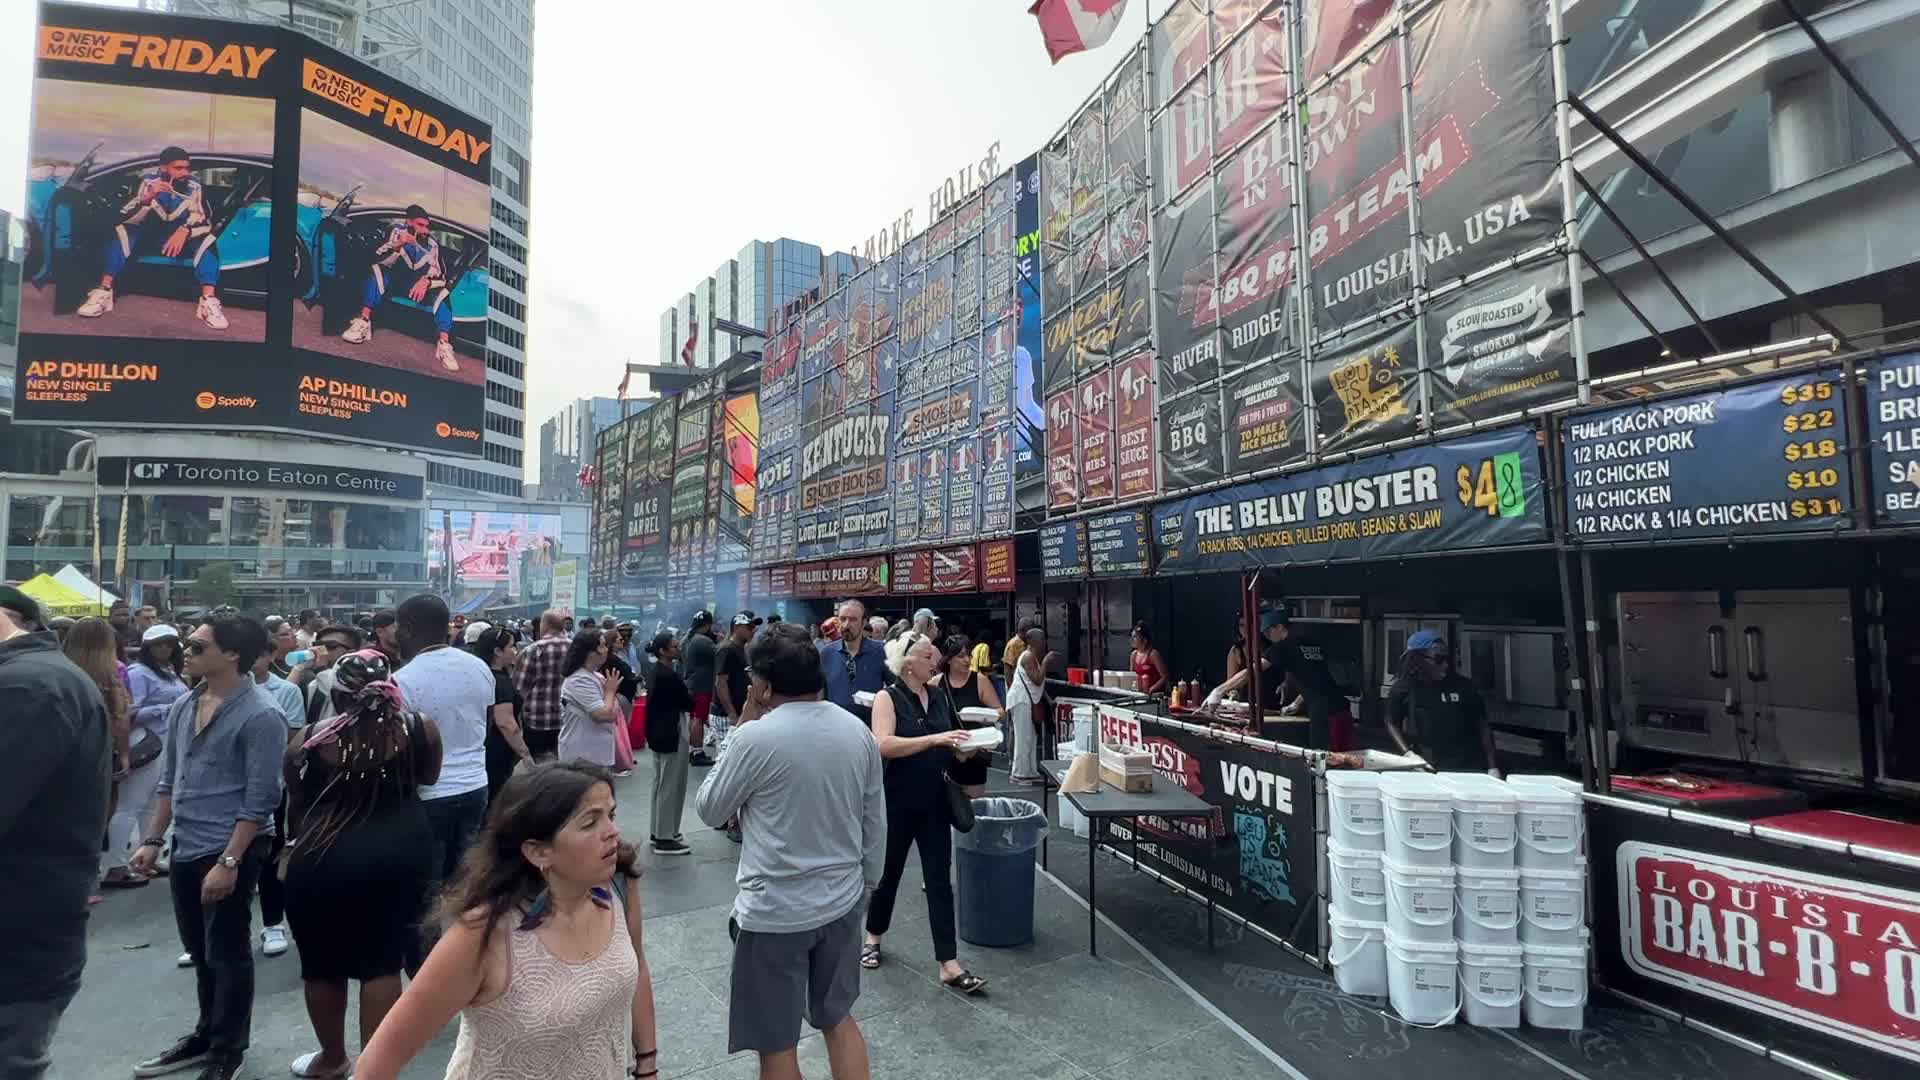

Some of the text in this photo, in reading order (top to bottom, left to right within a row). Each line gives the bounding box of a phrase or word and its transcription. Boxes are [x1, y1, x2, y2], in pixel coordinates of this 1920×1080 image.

[46, 43, 106, 59] MUSIC
[67, 31, 111, 45] NEW
[107, 34, 277, 79] FRIDAY
[311, 78, 363, 108] MUSIC
[330, 74, 367, 97] NEW
[365, 92, 490, 165] FRIDAY
[851, 208, 913, 273] SMOKE
[929, 140, 1000, 226] HOUSE
[1243, 178, 1269, 209] IN
[1208, 265, 1259, 310] BBQ
[1335, 138, 1443, 236] TEAM
[1466, 194, 1532, 246] USA
[1456, 302, 1524, 330] SLOW ROASTED
[1173, 308, 1282, 375] RIVER RIDGE
[25, 361, 157, 381] AP DHILLON
[26, 379, 112, 392] NEW SINGLE
[25, 391, 88, 402] SLEEPLESS
[217, 396, 257, 408] Spotify
[299, 375, 408, 408] AP DHILLON
[299, 392, 371, 413] NEW SINGLE
[299, 403, 352, 420] SLEEPLESS
[913, 399, 962, 430] SMOKD
[1571, 382, 1832, 442] FULL RACK PORK $35
[1880, 397, 1920, 423] BR
[451, 427, 481, 441] Spotify
[1084, 432, 1105, 449] BEST
[1120, 427, 1148, 449] BEST
[1171, 422, 1208, 451] BBQ
[1241, 419, 1287, 441] TO MAKE A
[1572, 410, 1833, 464] 1/2 RACK PORK $22
[802, 415, 889, 481] KENTUCKY
[1120, 445, 1148, 466] SAUCE
[1240, 439, 1260, 452] NICE
[134, 463, 397, 492] CF Toronto Eaton Centre
[1085, 456, 1106, 473] RIBS
[1573, 439, 1836, 487] 1/2 CHICKEN $18
[1195, 505, 1233, 536] THE
[1239, 485, 1311, 529] BELLY
[1316, 466, 1438, 518] BUSTER
[1574, 468, 1838, 511] 1/4 CHICKEN $10
[1576, 498, 1840, 535] 1/2 RACK & 1/4 CHICKEN $31
[1206, 538, 1226, 554] RACK
[1226, 536, 1246, 553] RIBS,
[1247, 534, 1258, 549] 1/4
[1260, 530, 1293, 547] CHICKEN,
[1297, 522, 1329, 544] PULLED
[1329, 515, 1361, 541] PORK,
[1362, 514, 1396, 536] BEANS
[1398, 513, 1408, 531] &
[1410, 509, 1441, 530] SLAW
[832, 567, 869, 581] PLATTER
[1220, 760, 1293, 815] VOTE
[1110, 821, 1132, 841] RIVER
